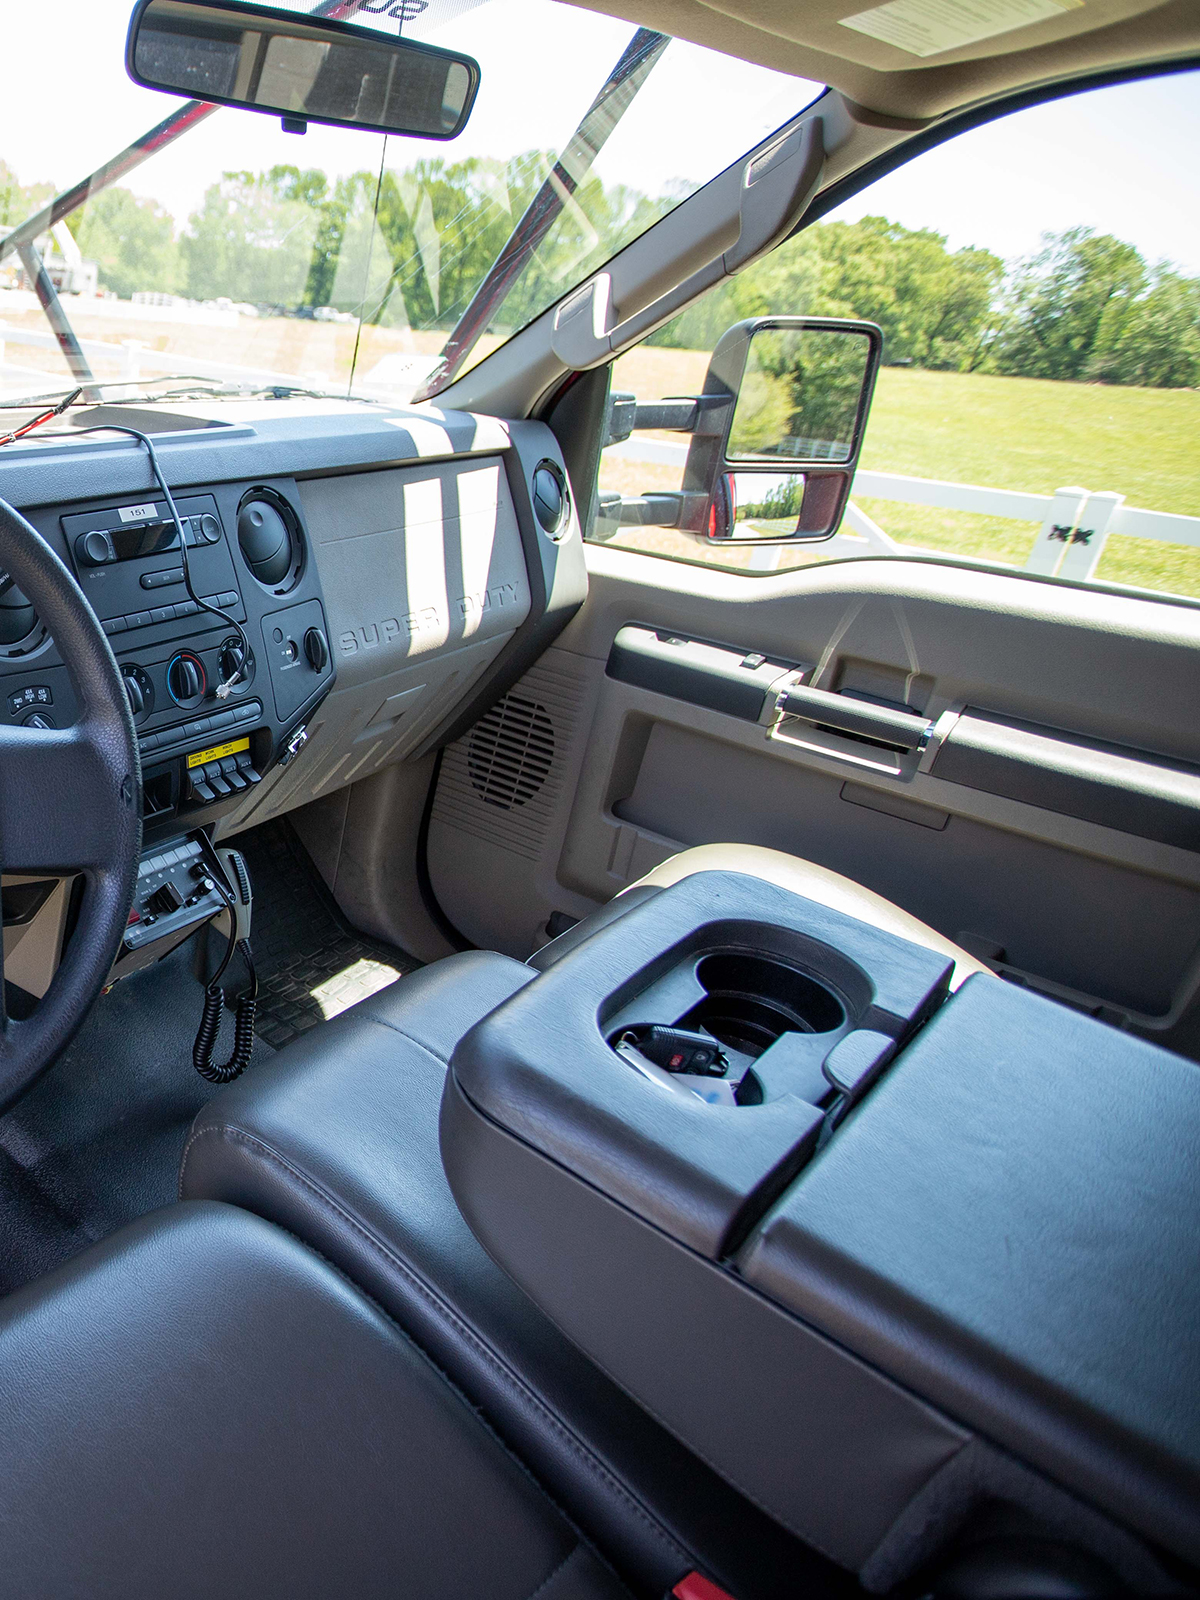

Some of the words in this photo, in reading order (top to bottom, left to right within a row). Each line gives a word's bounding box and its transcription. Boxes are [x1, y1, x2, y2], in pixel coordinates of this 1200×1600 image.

[129, 508, 146, 517] 151
[339, 606, 440, 657] SUPER
[456, 580, 520, 620] DUTY
